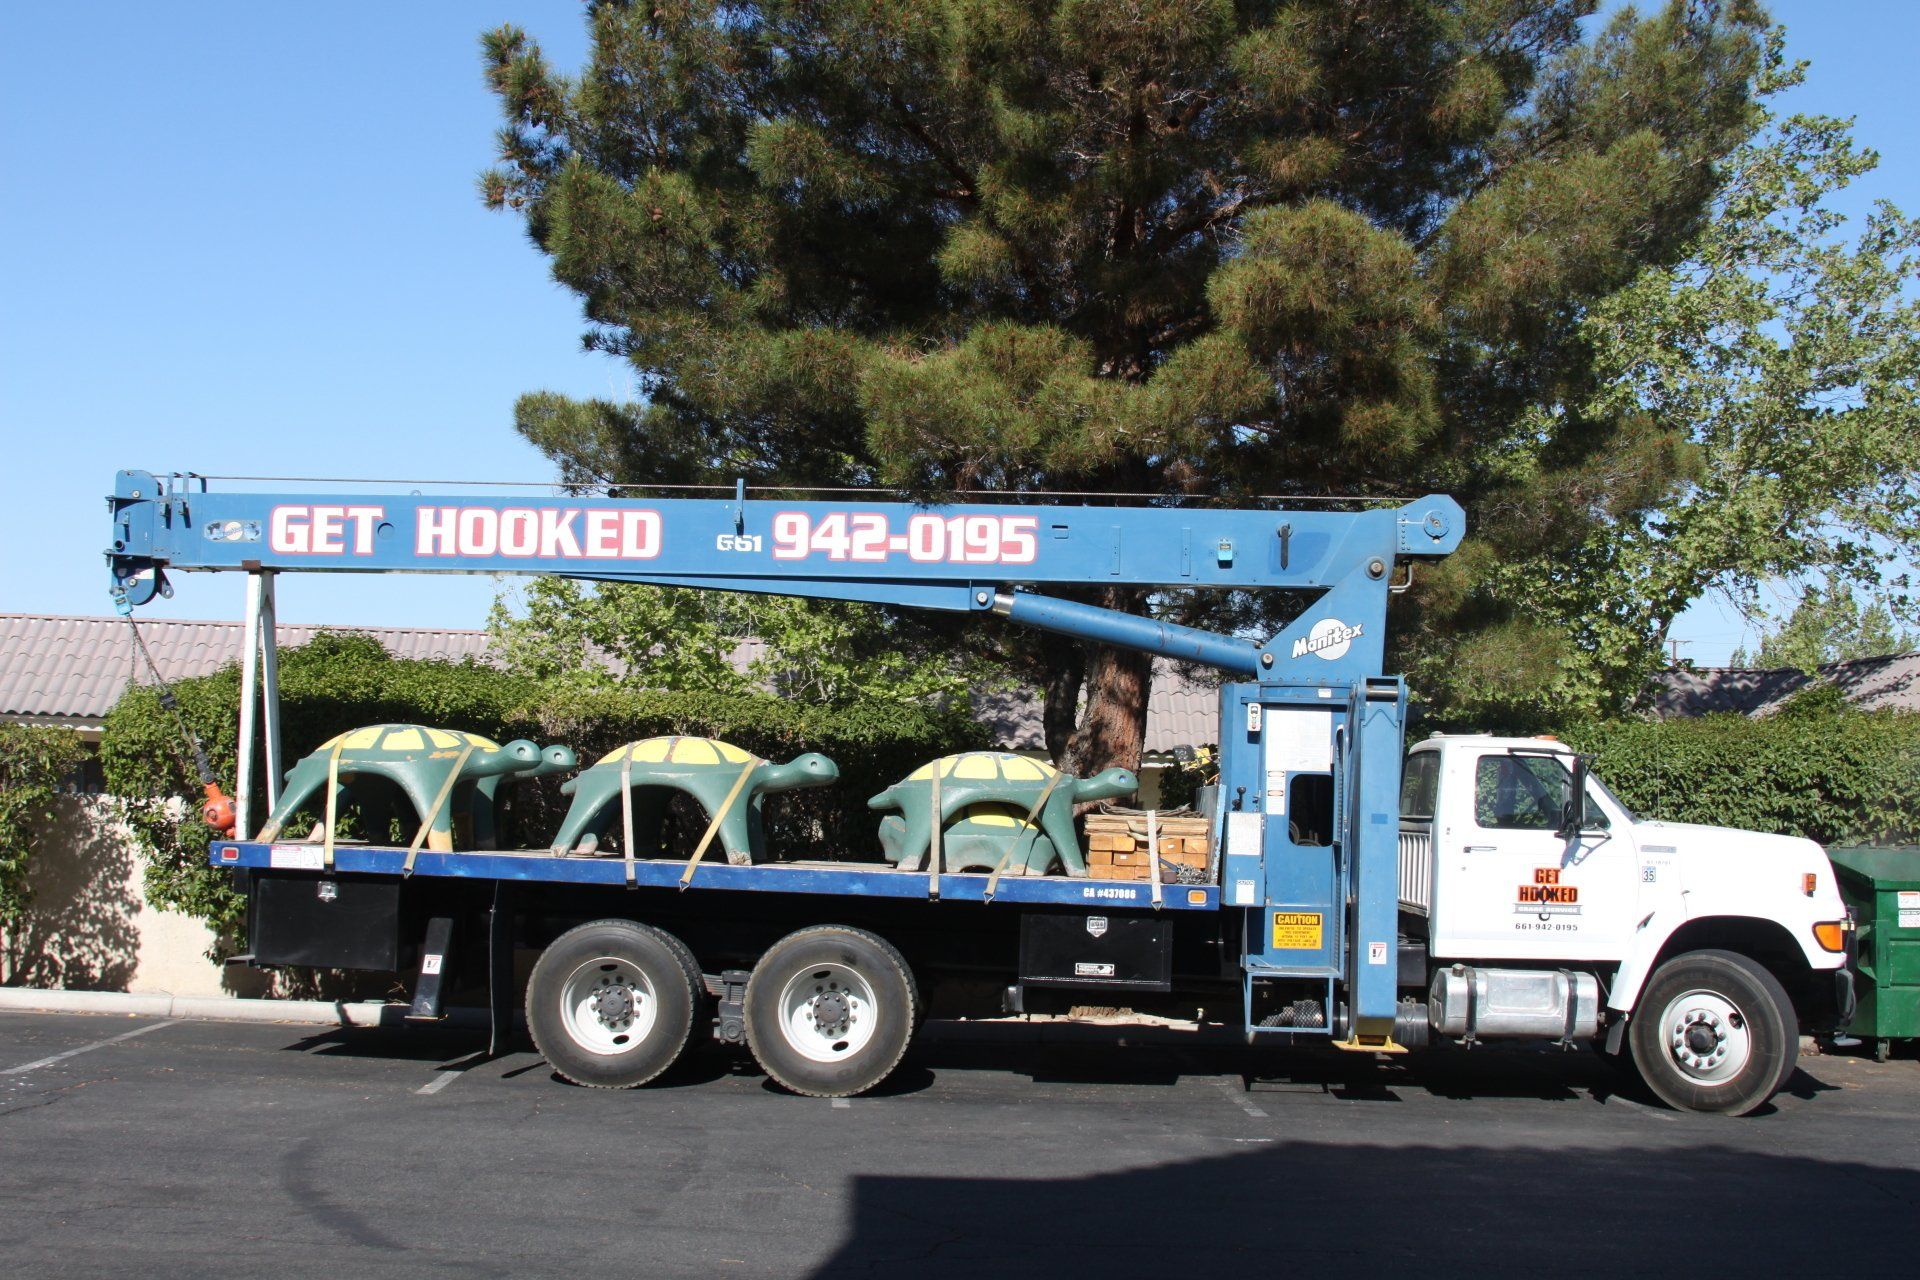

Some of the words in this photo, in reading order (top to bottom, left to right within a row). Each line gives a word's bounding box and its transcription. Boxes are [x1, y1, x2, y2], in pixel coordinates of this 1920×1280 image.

[270, 505, 384, 555] GET
[415, 507, 662, 559] HOOKED
[716, 534, 762, 552] 661
[773, 511, 1038, 565] 942-0195
[1290, 623, 1364, 659] Manitex
[1534, 868, 1561, 884] GET
[1643, 870, 1655, 881] 35
[1083, 887, 1095, 898] CA
[1518, 886, 1578, 903] HOOKED
[1277, 915, 1318, 925] CAUTION
[1515, 923, 1578, 931] 661-942-0195
